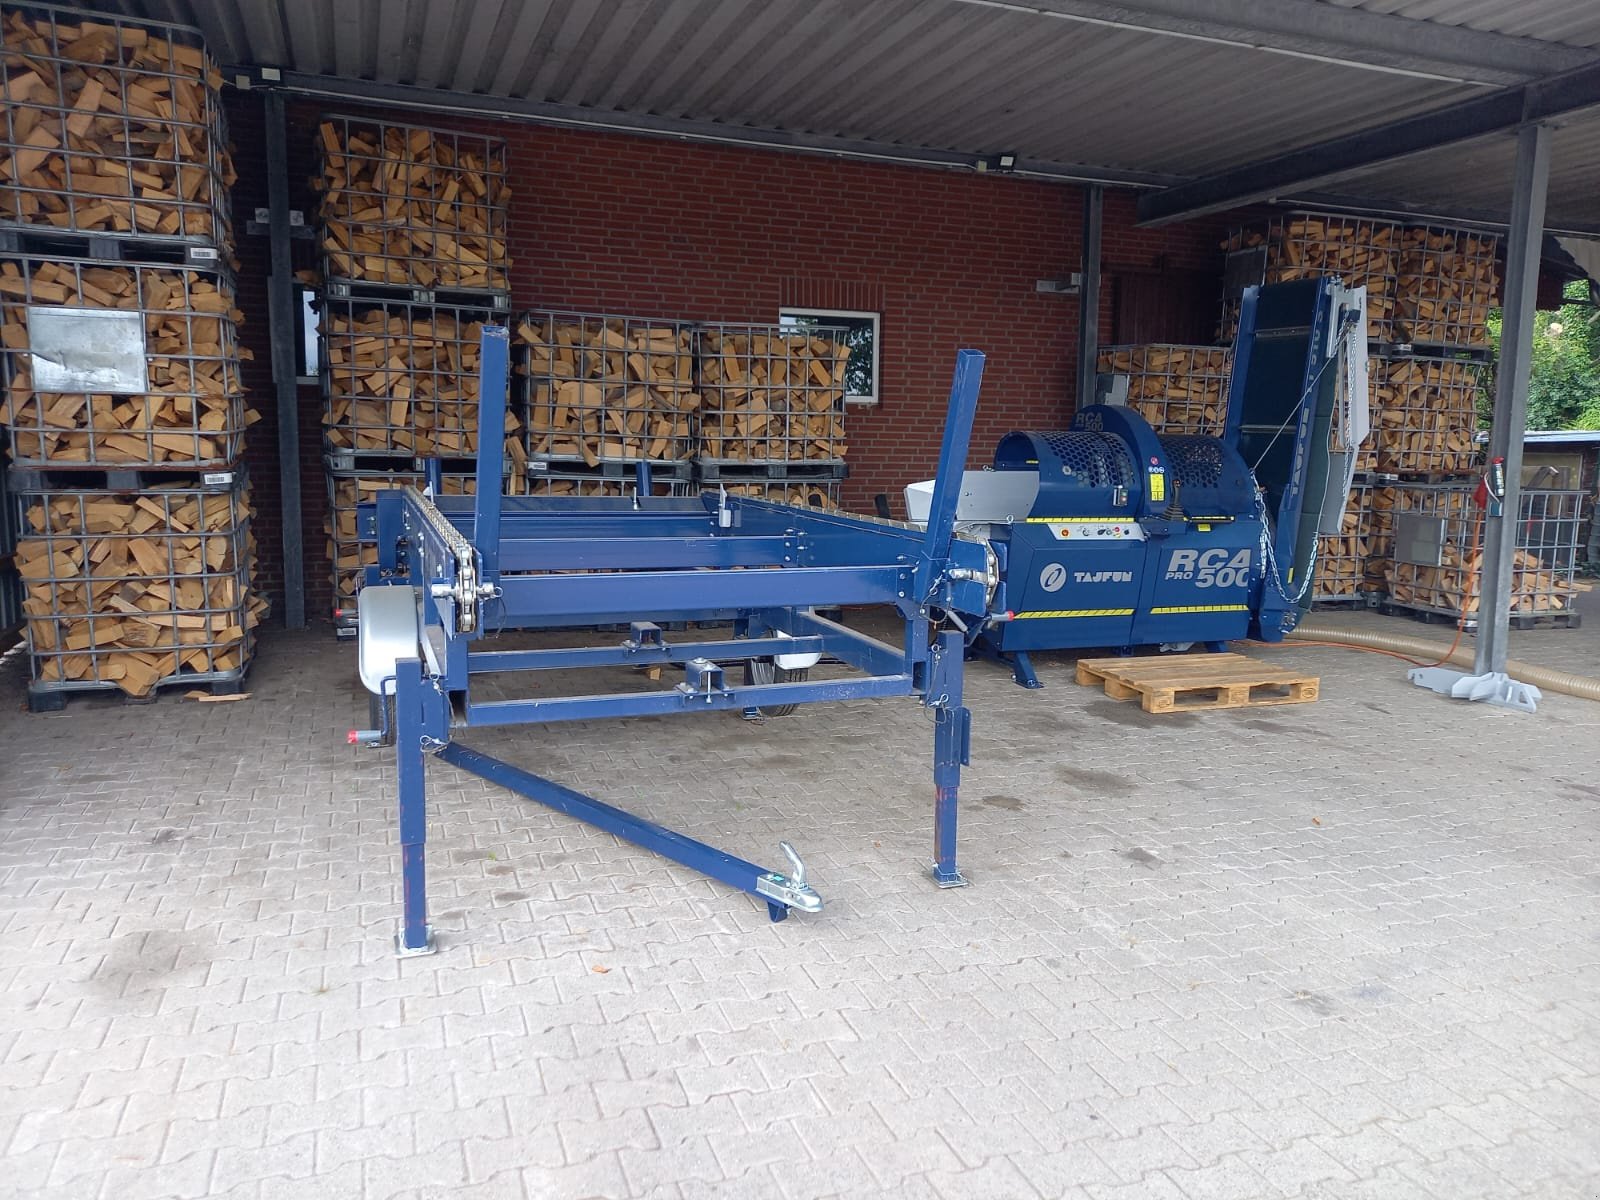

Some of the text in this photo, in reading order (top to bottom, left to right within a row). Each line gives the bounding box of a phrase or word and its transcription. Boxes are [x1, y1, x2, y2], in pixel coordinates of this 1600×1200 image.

[1076, 412, 1103, 424] RCA
[1084, 422, 1104, 431] 500
[1167, 548, 1251, 572] RCA
[1074, 571, 1133, 583] TAJFUN
[1164, 571, 1194, 580] PRO
